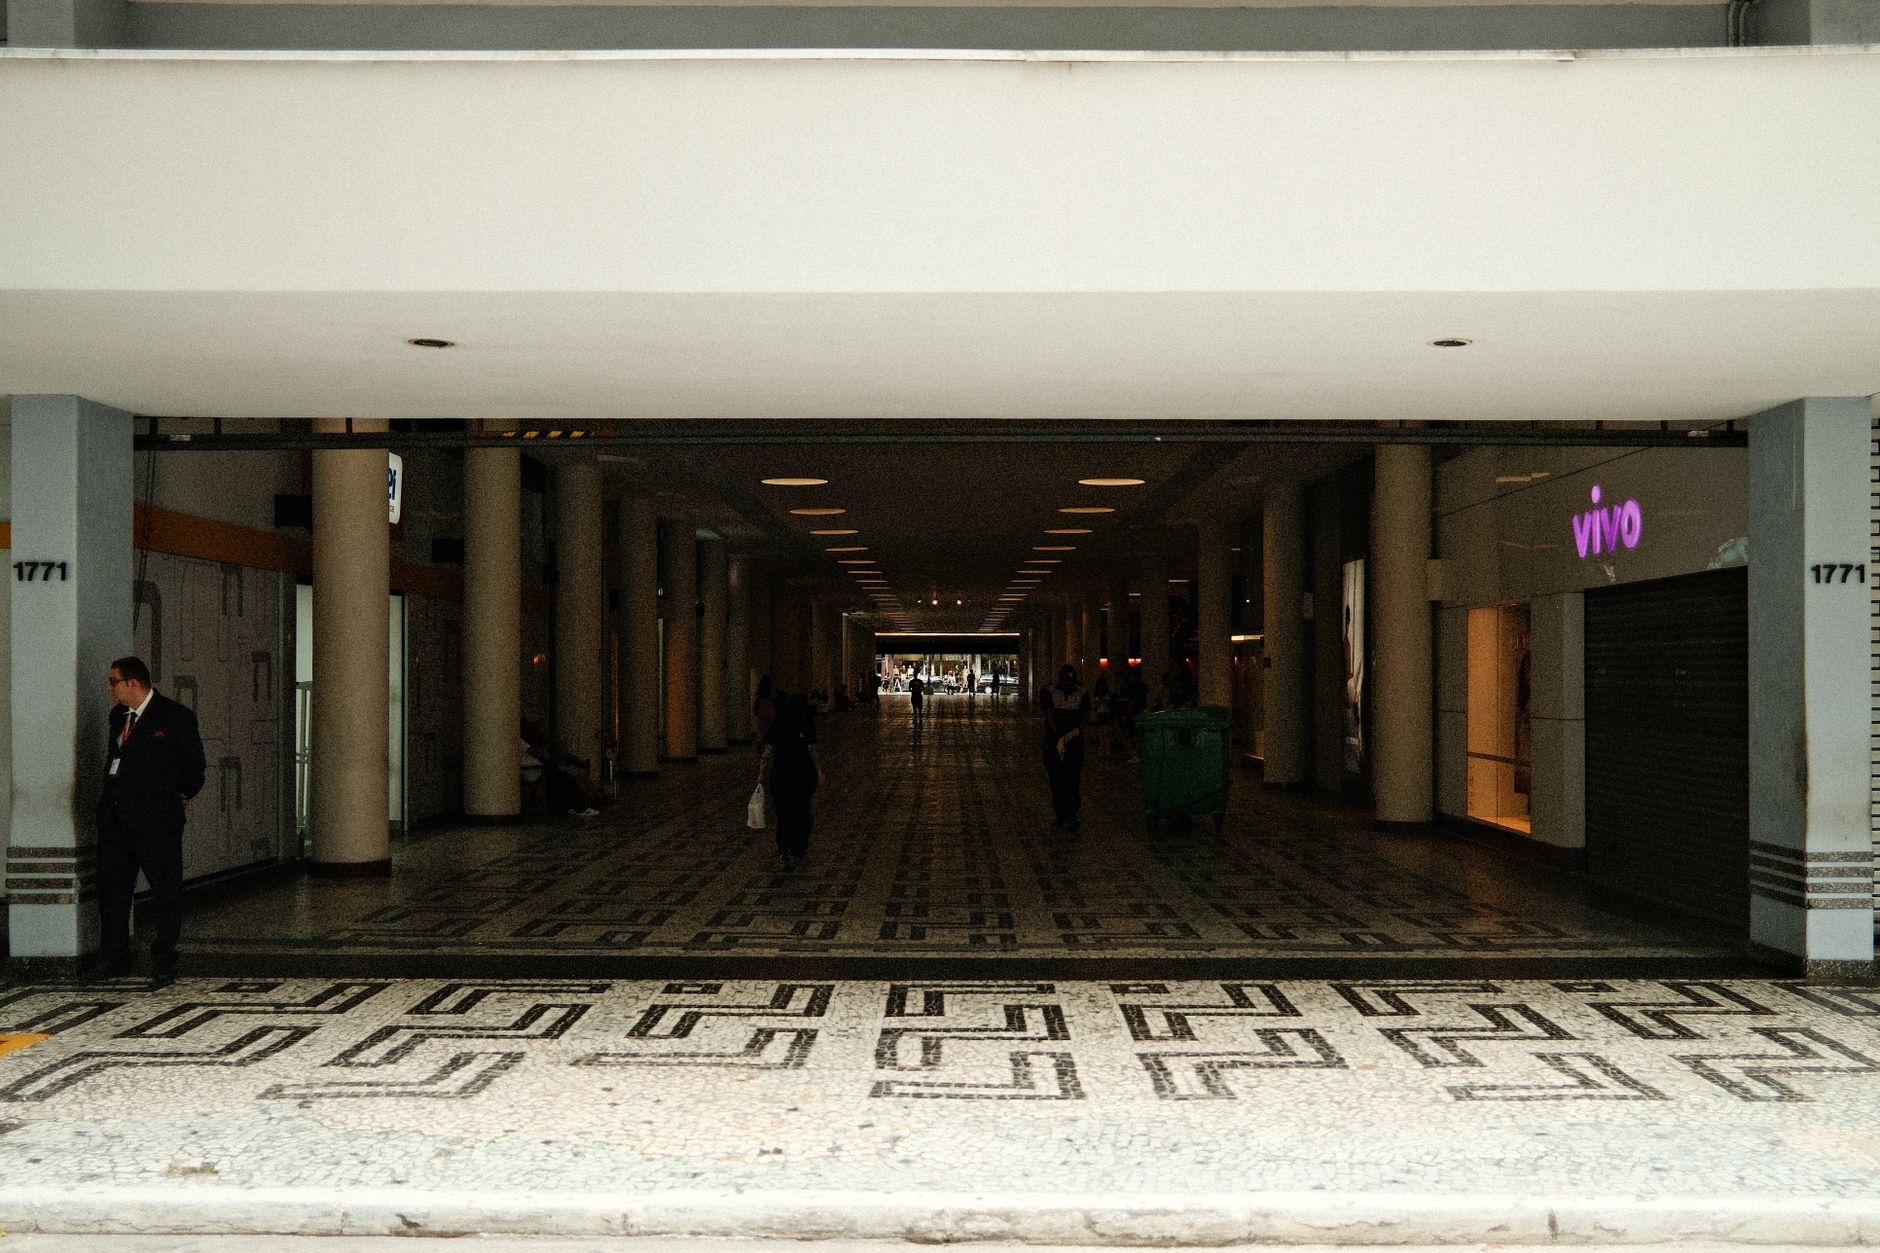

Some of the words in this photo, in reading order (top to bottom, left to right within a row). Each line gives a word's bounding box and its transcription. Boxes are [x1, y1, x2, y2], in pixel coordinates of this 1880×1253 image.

[1572, 484, 1642, 559] vivo
[13, 561, 66, 582] 1771
[1811, 564, 1865, 584] 1771
